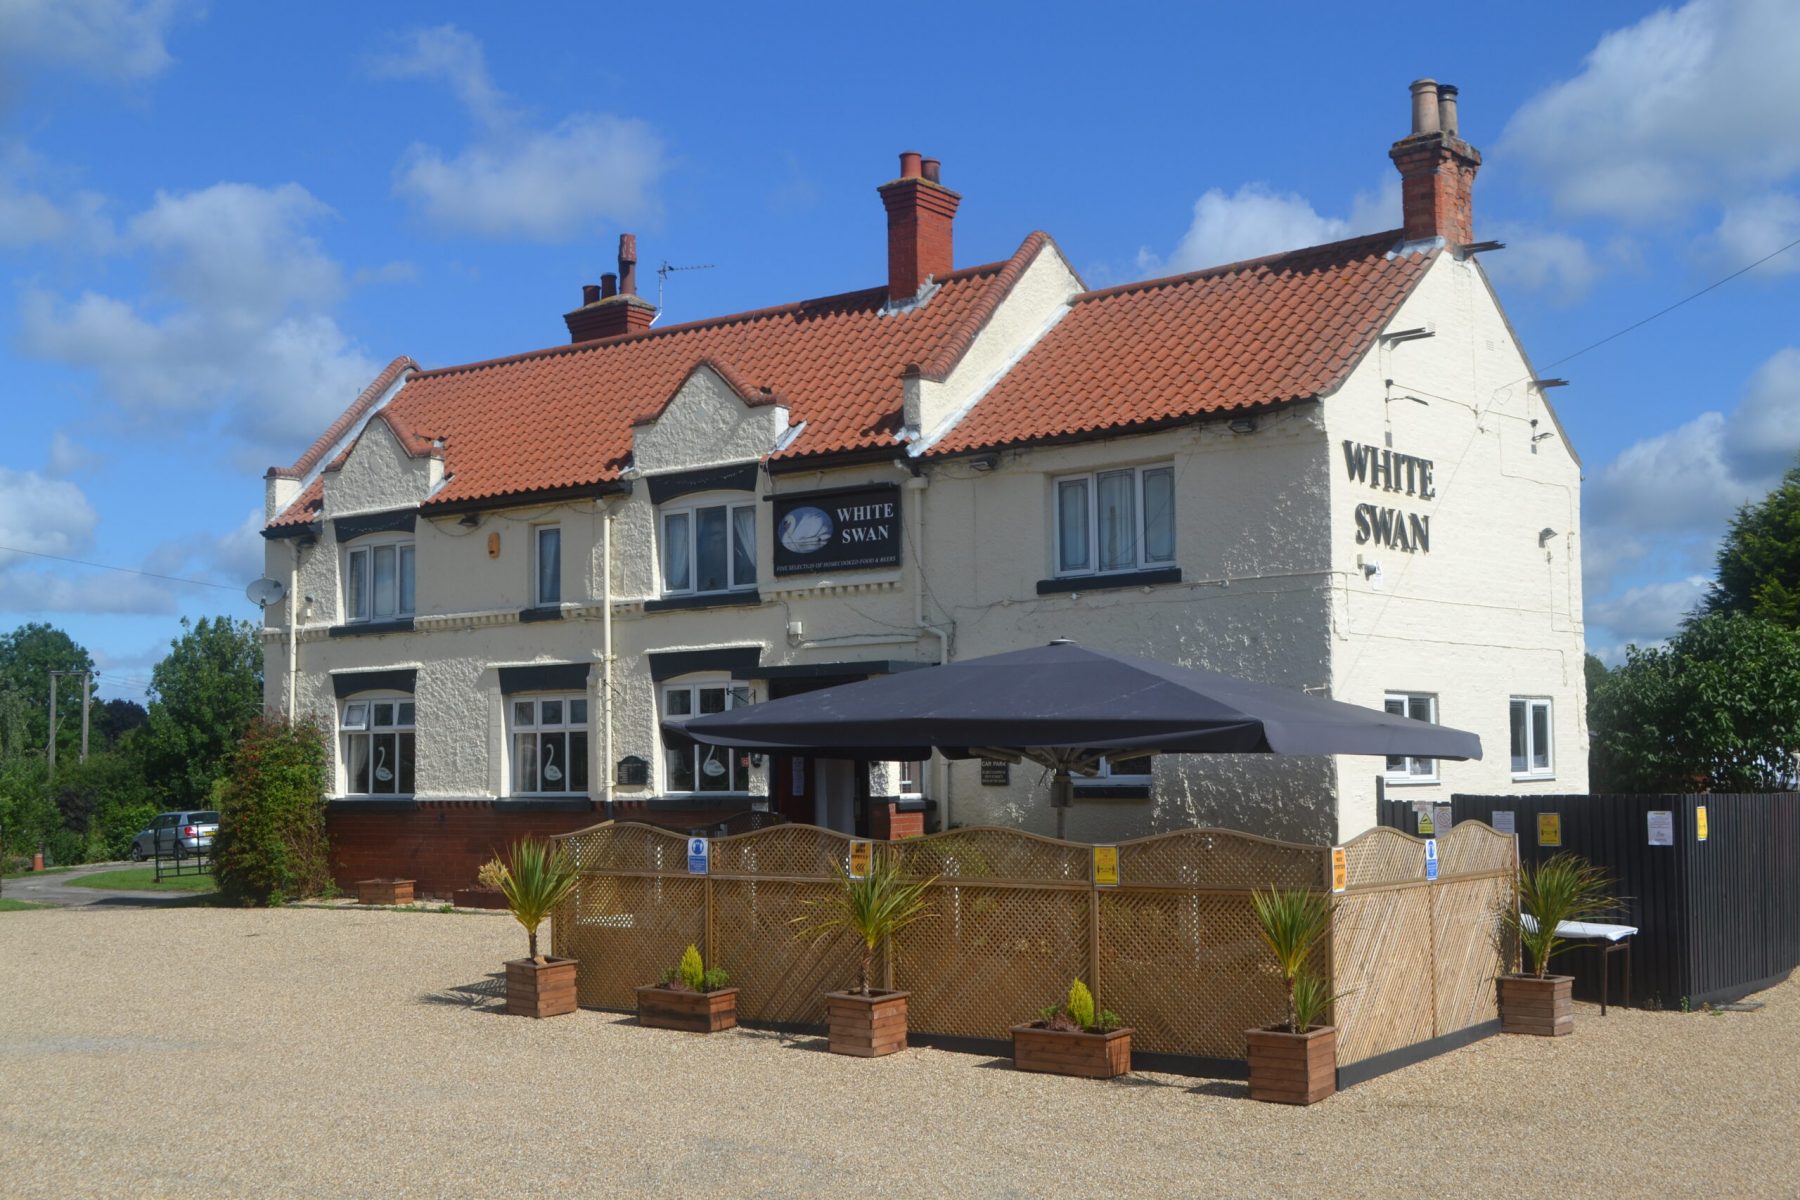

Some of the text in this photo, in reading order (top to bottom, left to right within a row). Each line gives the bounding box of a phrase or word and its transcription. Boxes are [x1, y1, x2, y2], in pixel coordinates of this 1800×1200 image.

[1342, 440, 1435, 501] WHITE
[836, 503, 894, 522] WHITE
[1355, 503, 1430, 555] SWAN
[842, 525, 889, 544] SWAN
